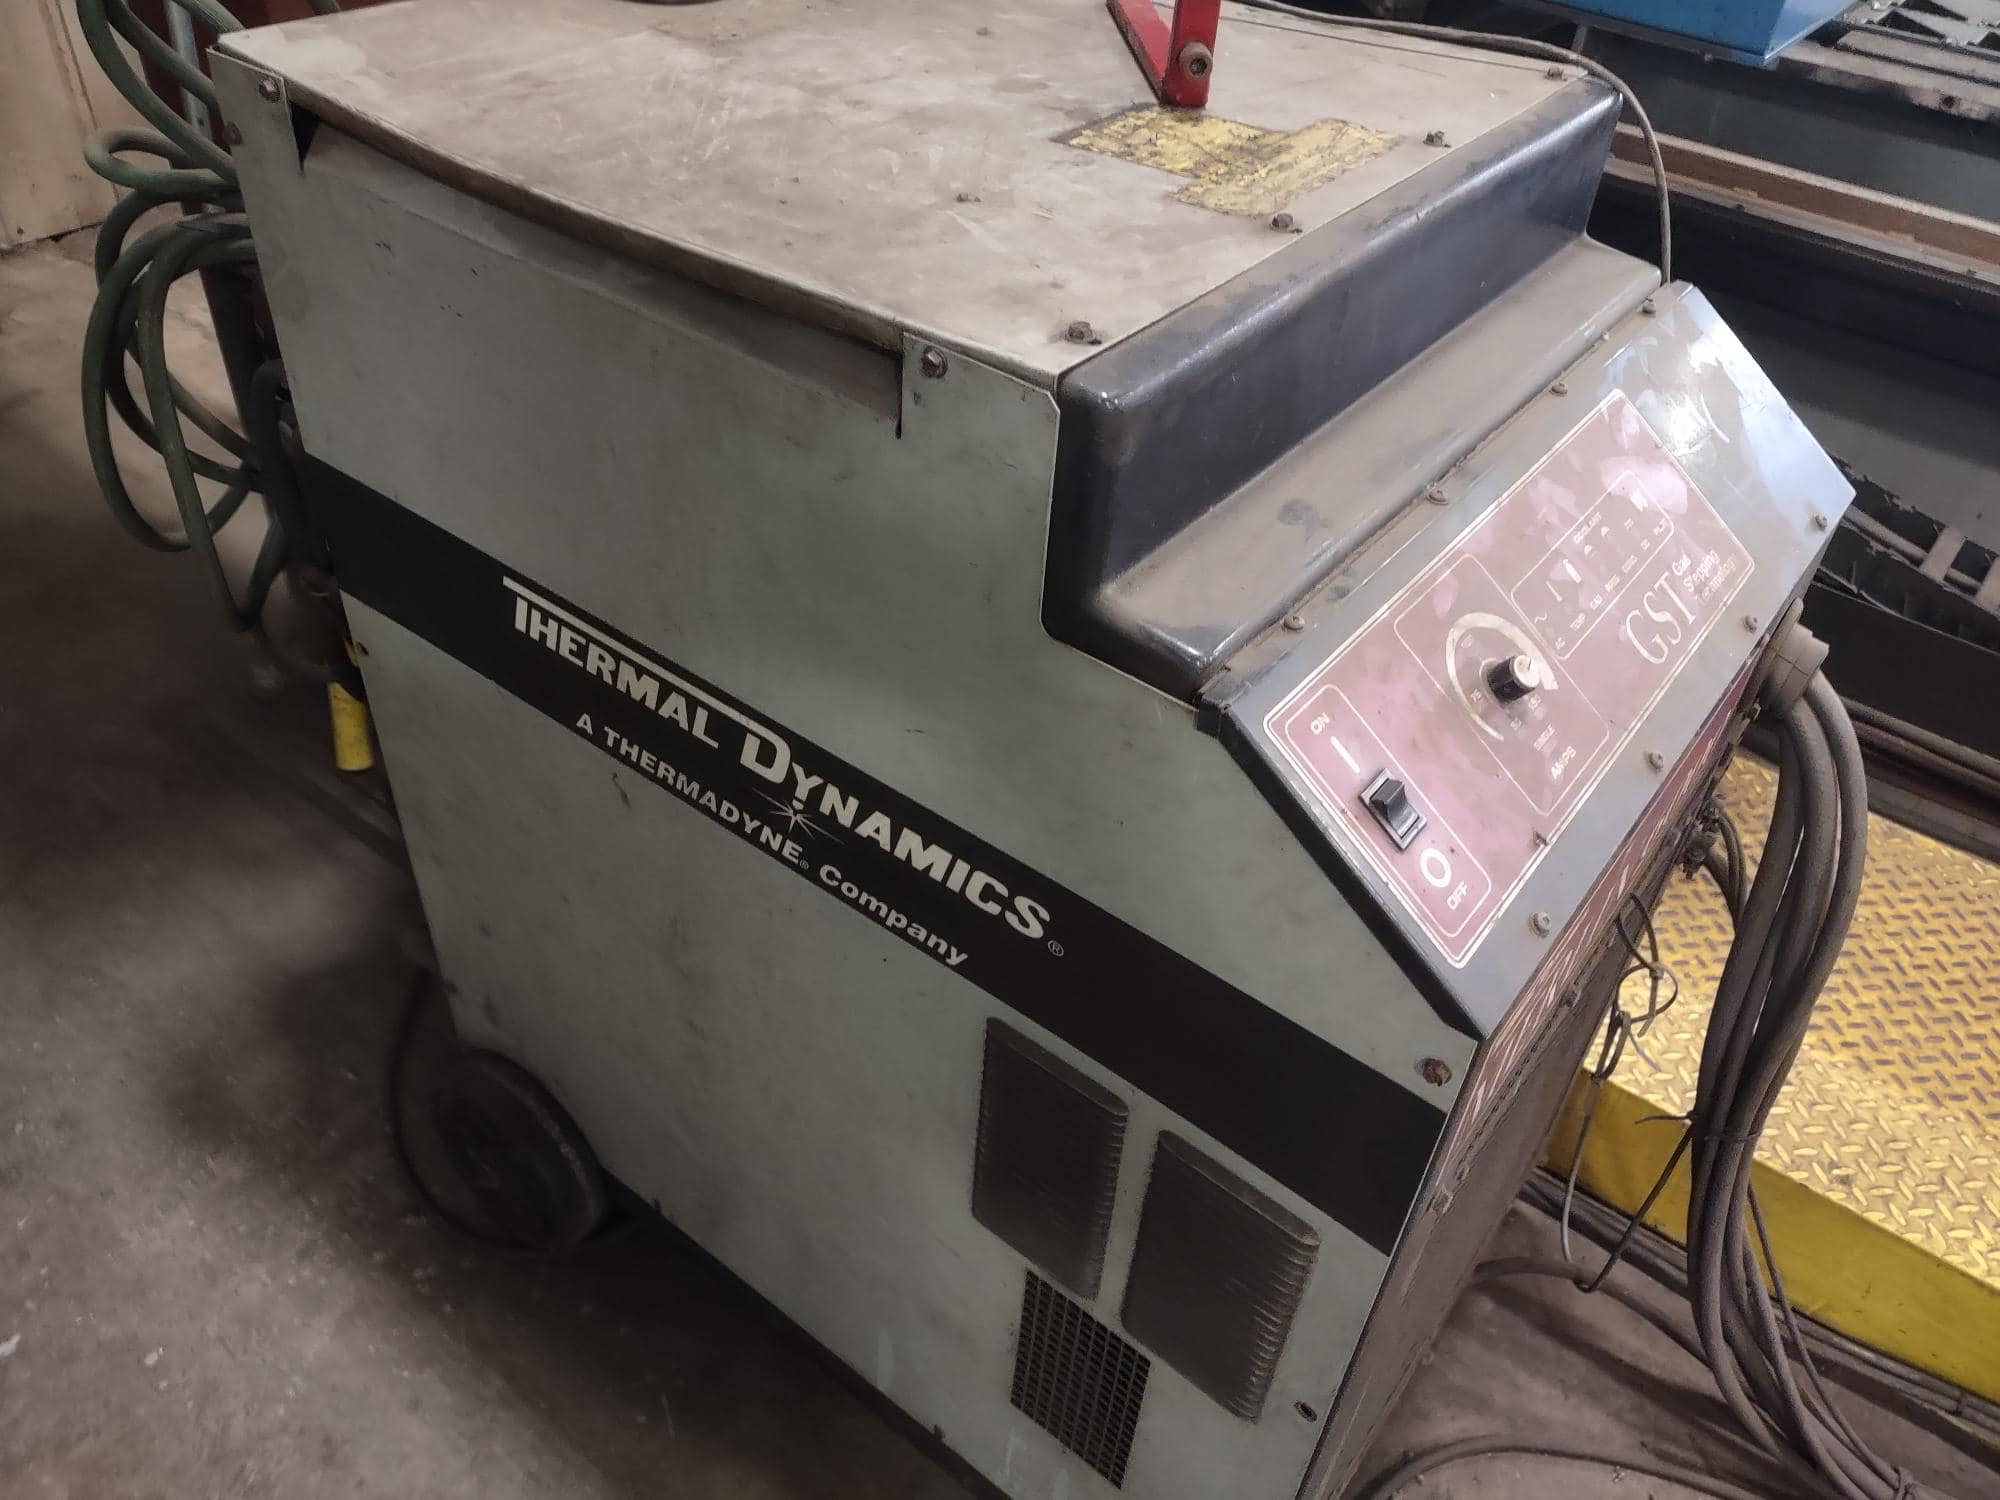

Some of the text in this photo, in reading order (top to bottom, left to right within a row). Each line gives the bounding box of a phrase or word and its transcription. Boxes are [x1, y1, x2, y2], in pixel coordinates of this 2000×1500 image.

[1672, 554, 1692, 577] Gas
[1625, 571, 1697, 665] GST
[503, 576, 719, 749] THERMAL
[1310, 711, 1331, 735] ON
[1551, 745, 1577, 780] AMPS
[576, 712, 594, 736] A
[819, 864, 969, 966] Company
[1446, 880, 1468, 911] OFF
